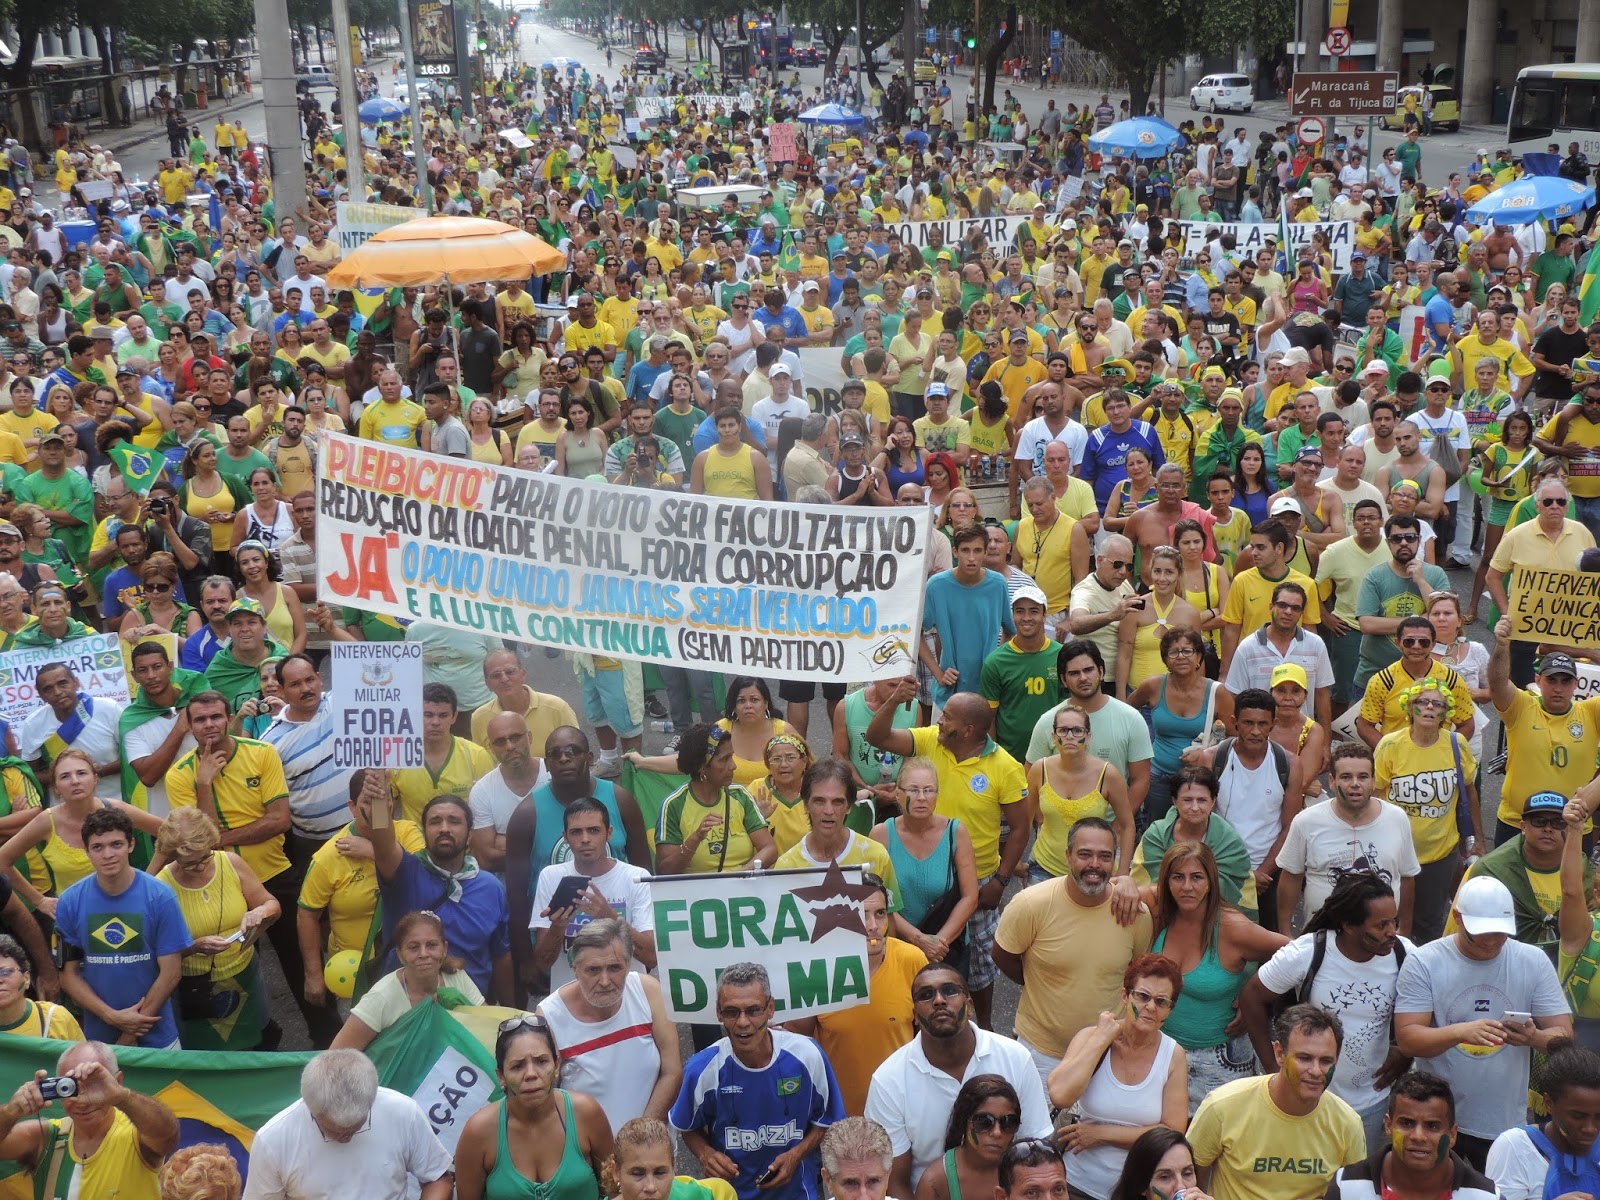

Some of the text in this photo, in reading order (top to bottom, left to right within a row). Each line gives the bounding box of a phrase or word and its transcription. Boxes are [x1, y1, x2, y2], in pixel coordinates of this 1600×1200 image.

[421, 64, 450, 75] 16:10
[1311, 80, 1370, 91] Maracanã
[1328, 97, 1341, 108] da
[1348, 97, 1380, 110] Tijuca
[782, 146, 793, 159] PT
[919, 217, 1009, 247] MILITAR
[621, 318, 630, 329] 11
[1025, 376, 1031, 384] 9
[972, 435, 995, 449] BRASIL
[712, 470, 744, 480] BRASIL
[490, 473, 561, 521] PARA
[562, 486, 584, 525] O
[586, 489, 652, 533] VOTO
[655, 498, 709, 540] SER
[321, 477, 423, 537] REDUÇÃO
[428, 503, 461, 545] DA
[464, 509, 538, 560] IDADE
[640, 537, 708, 584] FORA
[715, 547, 898, 599] CORRUPÇÃO
[401, 540, 420, 585] O
[419, 543, 485, 599] POVO
[487, 556, 571, 614] UNIDO
[573, 572, 685, 626] JAMAIS
[687, 583, 755, 632] SERÁ
[1517, 568, 1600, 597] INTERVEN
[1517, 590, 1600, 619] É A ÚNICA
[406, 587, 422, 618] E
[429, 592, 449, 623] A
[450, 596, 521, 637] LUTA
[527, 611, 673, 659] CONTINUA
[678, 626, 733, 664] (SEM
[740, 635, 845, 676] PARTIDO)
[1518, 615, 1600, 644] SOLUÇÃ
[0, 636, 106, 669] INTERVENÇÃO
[354, 688, 401, 702] MILITAR
[1024, 676, 1046, 696] 10
[343, 707, 415, 736] FORA
[334, 736, 423, 768] CORRUPTOS
[1550, 746, 1569, 768] 10
[1531, 795, 1562, 804] GLOBE
[653, 892, 811, 952] FORA
[114, 954, 119, 964] É
[668, 954, 869, 1013] DMA
[725, 1118, 804, 1151] BRAZIL
[1253, 1156, 1328, 1175] BRASIL
